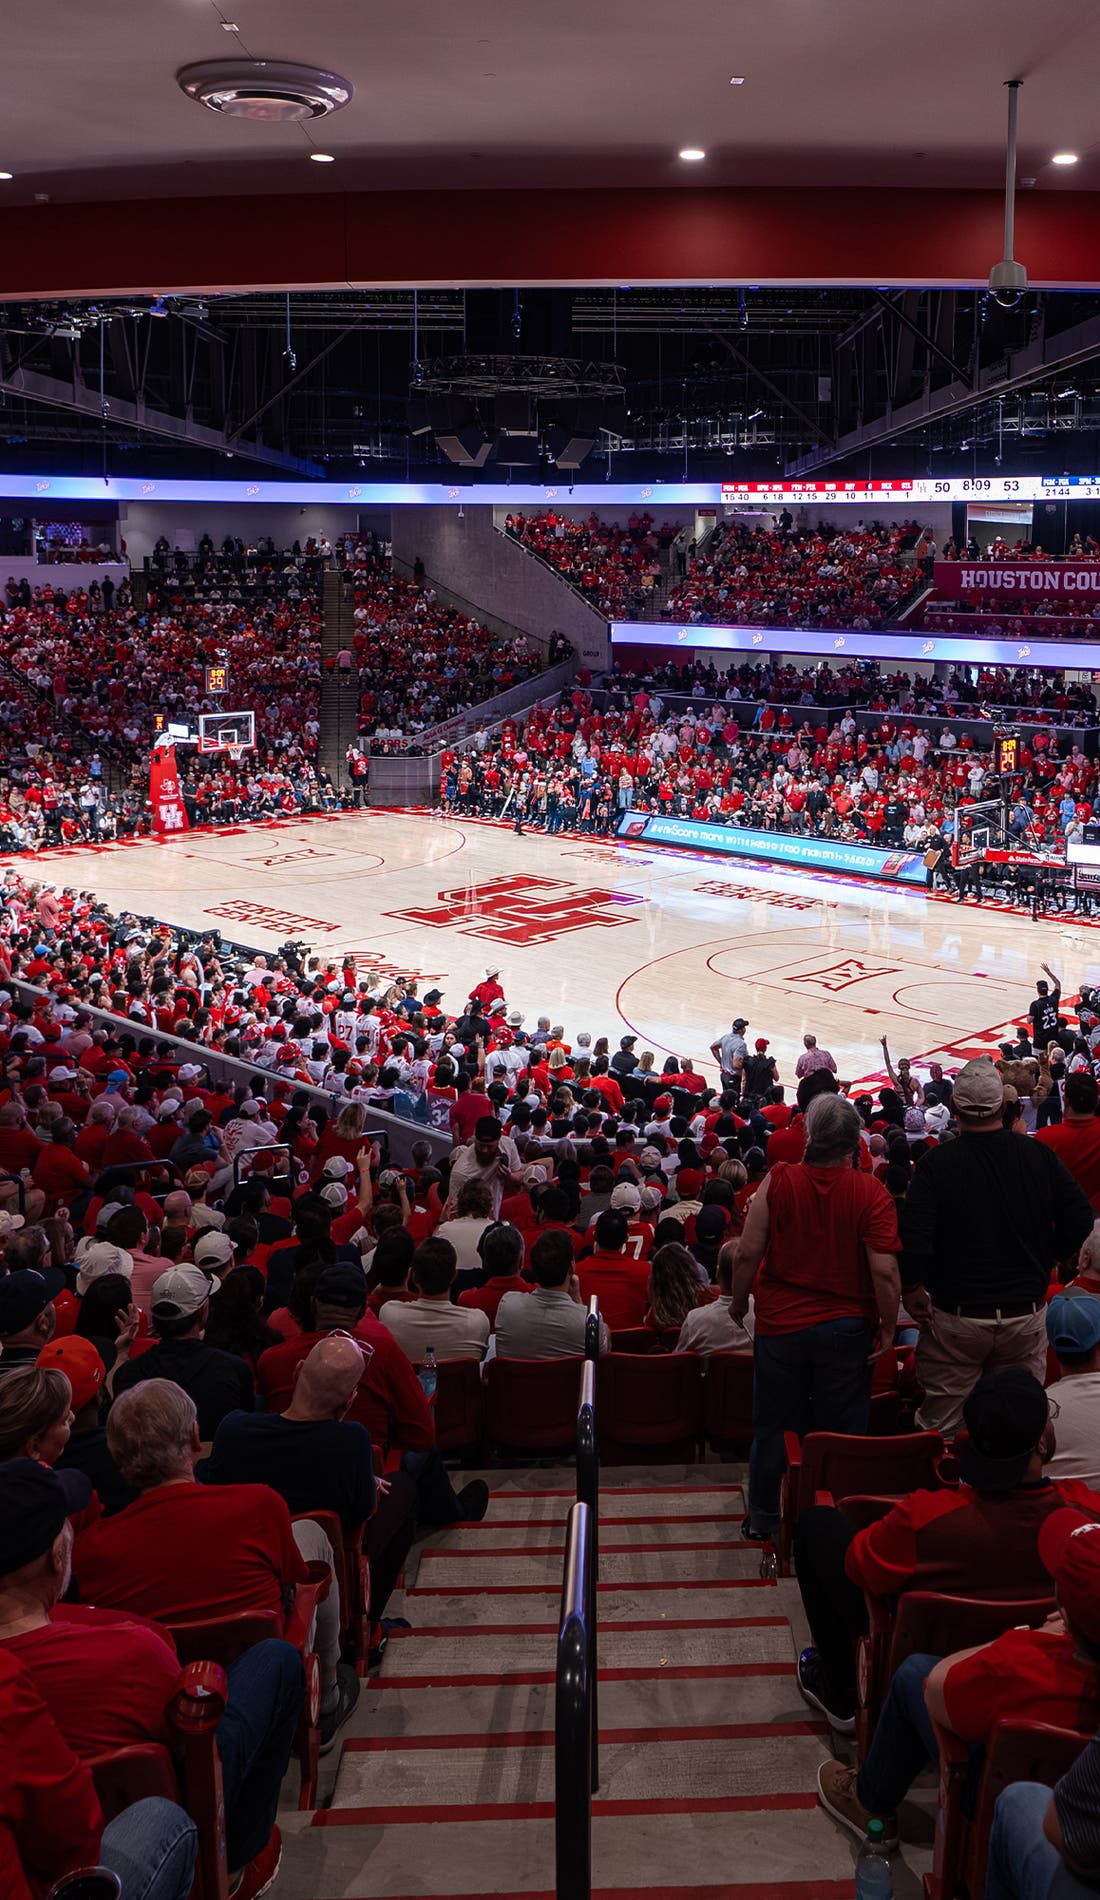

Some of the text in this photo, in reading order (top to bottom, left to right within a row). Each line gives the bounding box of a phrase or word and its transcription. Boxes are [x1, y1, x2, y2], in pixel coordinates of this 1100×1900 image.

[934, 482, 950, 493] 50
[962, 480, 991, 491] 8:09
[1003, 481, 1019, 492] 53
[1058, 487, 1070, 496] 44
[1086, 487, 1092, 496] 3
[738, 493, 749, 501] 40
[845, 492, 856, 500] 10
[864, 492, 874, 500] 11
[961, 570, 1060, 590] HOUSTON
[211, 669, 225, 677] 8:09
[1002, 739, 1017, 752] 8:09
[1001, 751, 1015, 772] 29
[671, 824, 698, 839] Score
[692, 887, 813, 911] CENTER
[700, 880, 839, 909] FERTITTA
[202, 907, 306, 935] CENTER
[219, 899, 342, 932] FERTITTA
[1042, 1012, 1058, 1030] 23
[337, 1024, 353, 1041] 27
[431, 1109, 450, 1127] 34
[620, 1235, 644, 1261] 7
